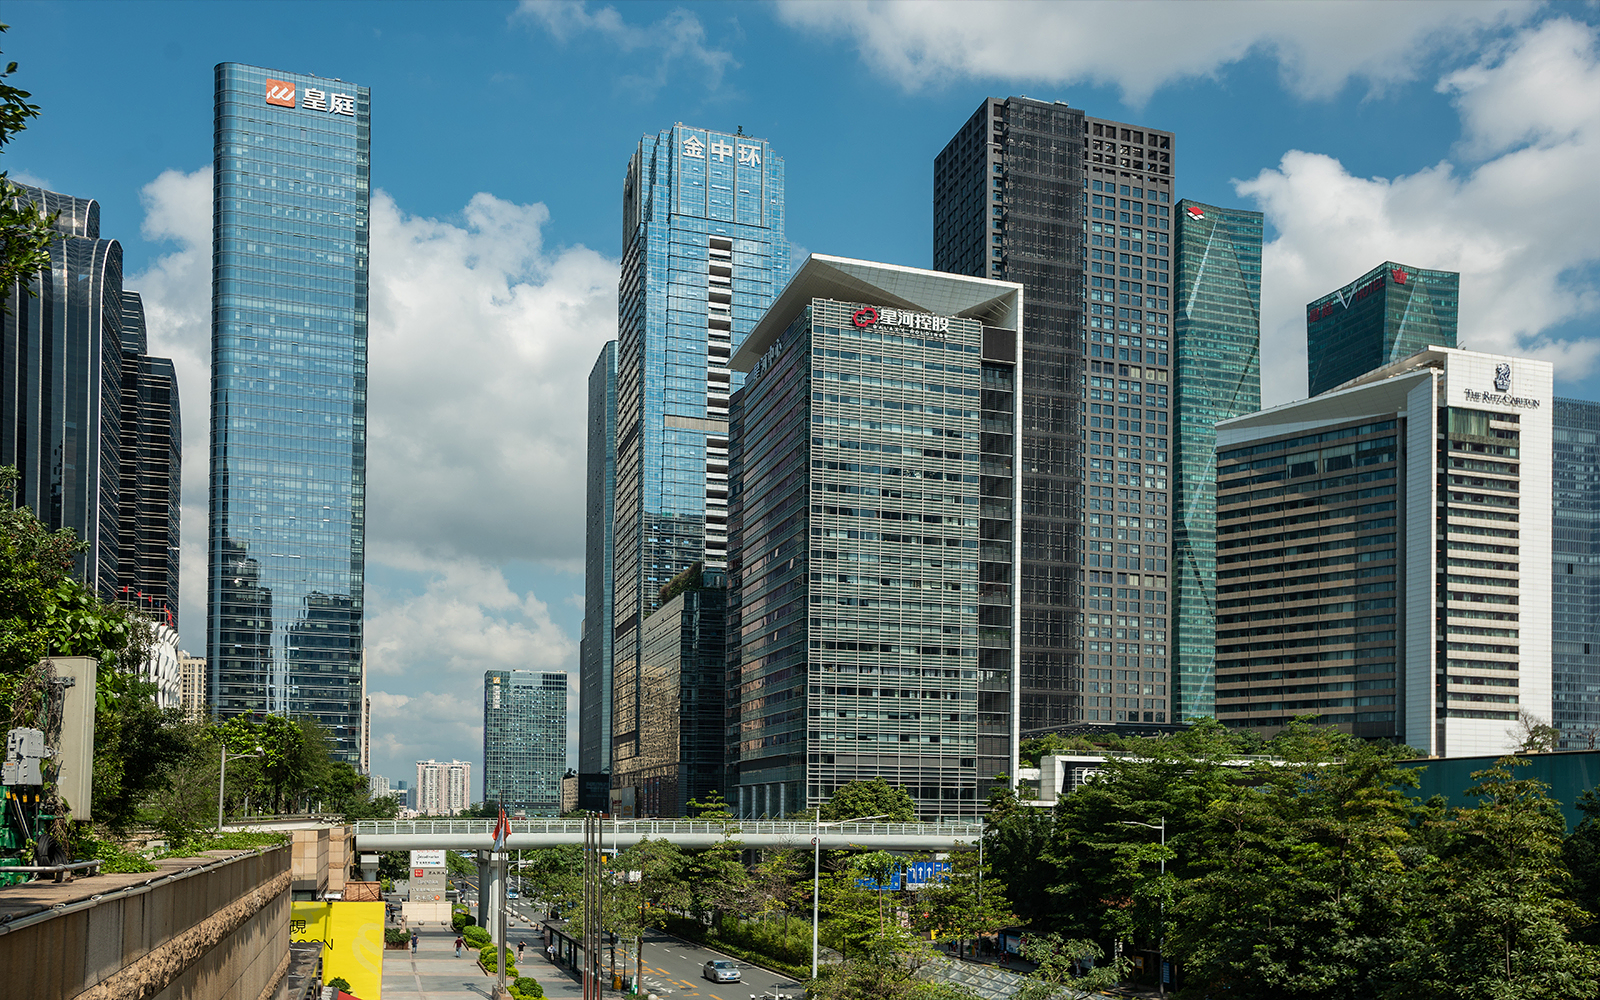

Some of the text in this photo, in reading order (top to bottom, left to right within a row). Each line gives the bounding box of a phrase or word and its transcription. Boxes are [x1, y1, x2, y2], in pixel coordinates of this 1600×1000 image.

[302, 88, 355, 117] 皇庭
[682, 135, 761, 168] 金中环
[1335, 280, 1359, 309] V
[1356, 277, 1385, 301] HOTEL
[880, 309, 949, 332] 星河控股
